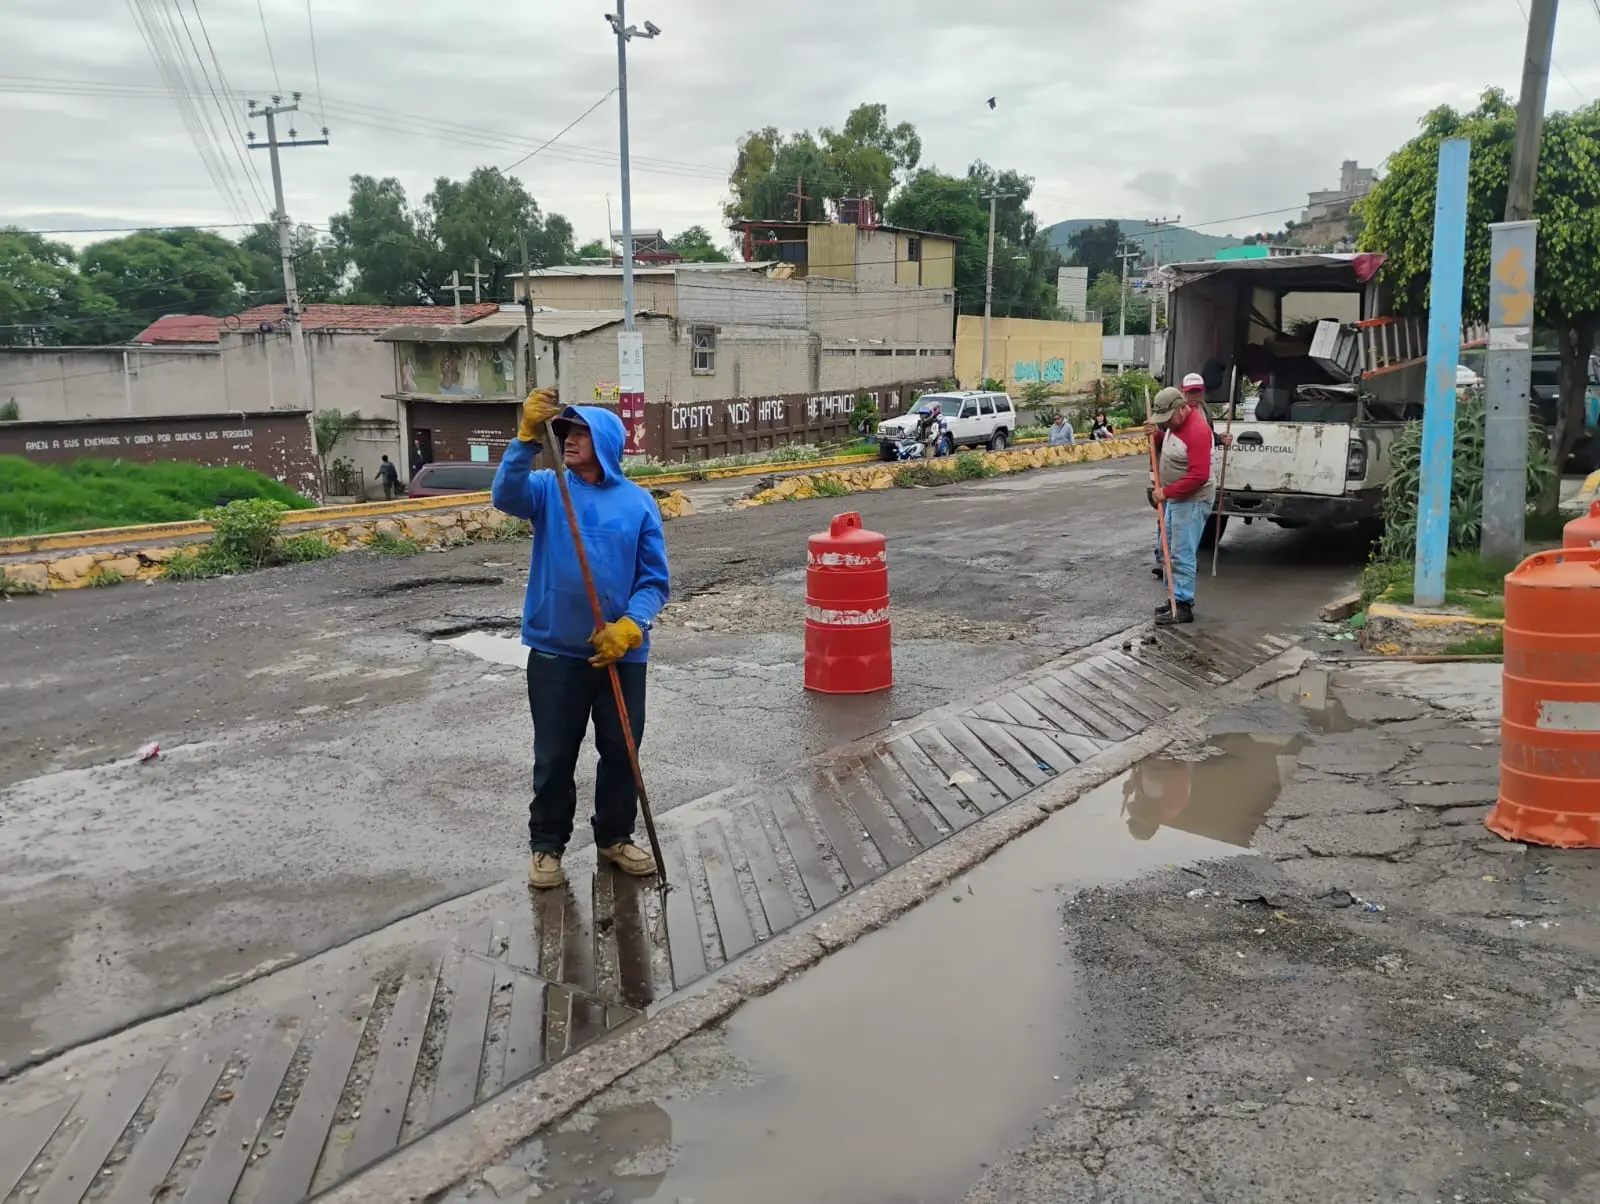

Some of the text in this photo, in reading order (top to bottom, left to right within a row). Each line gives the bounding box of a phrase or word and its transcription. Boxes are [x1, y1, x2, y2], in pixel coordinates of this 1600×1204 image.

[671, 405, 714, 430] CRISTO
[727, 402, 750, 425] NOS
[25, 440, 49, 451] AMEN
[52, 439, 60, 449] A
[63, 438, 80, 448] SUS
[123, 435, 131, 445] Y
[157, 433, 171, 442] POR
[174, 431, 202, 441] QUIENES
[205, 430, 218, 440] LOS
[1258, 444, 1294, 454] OFICIAL
